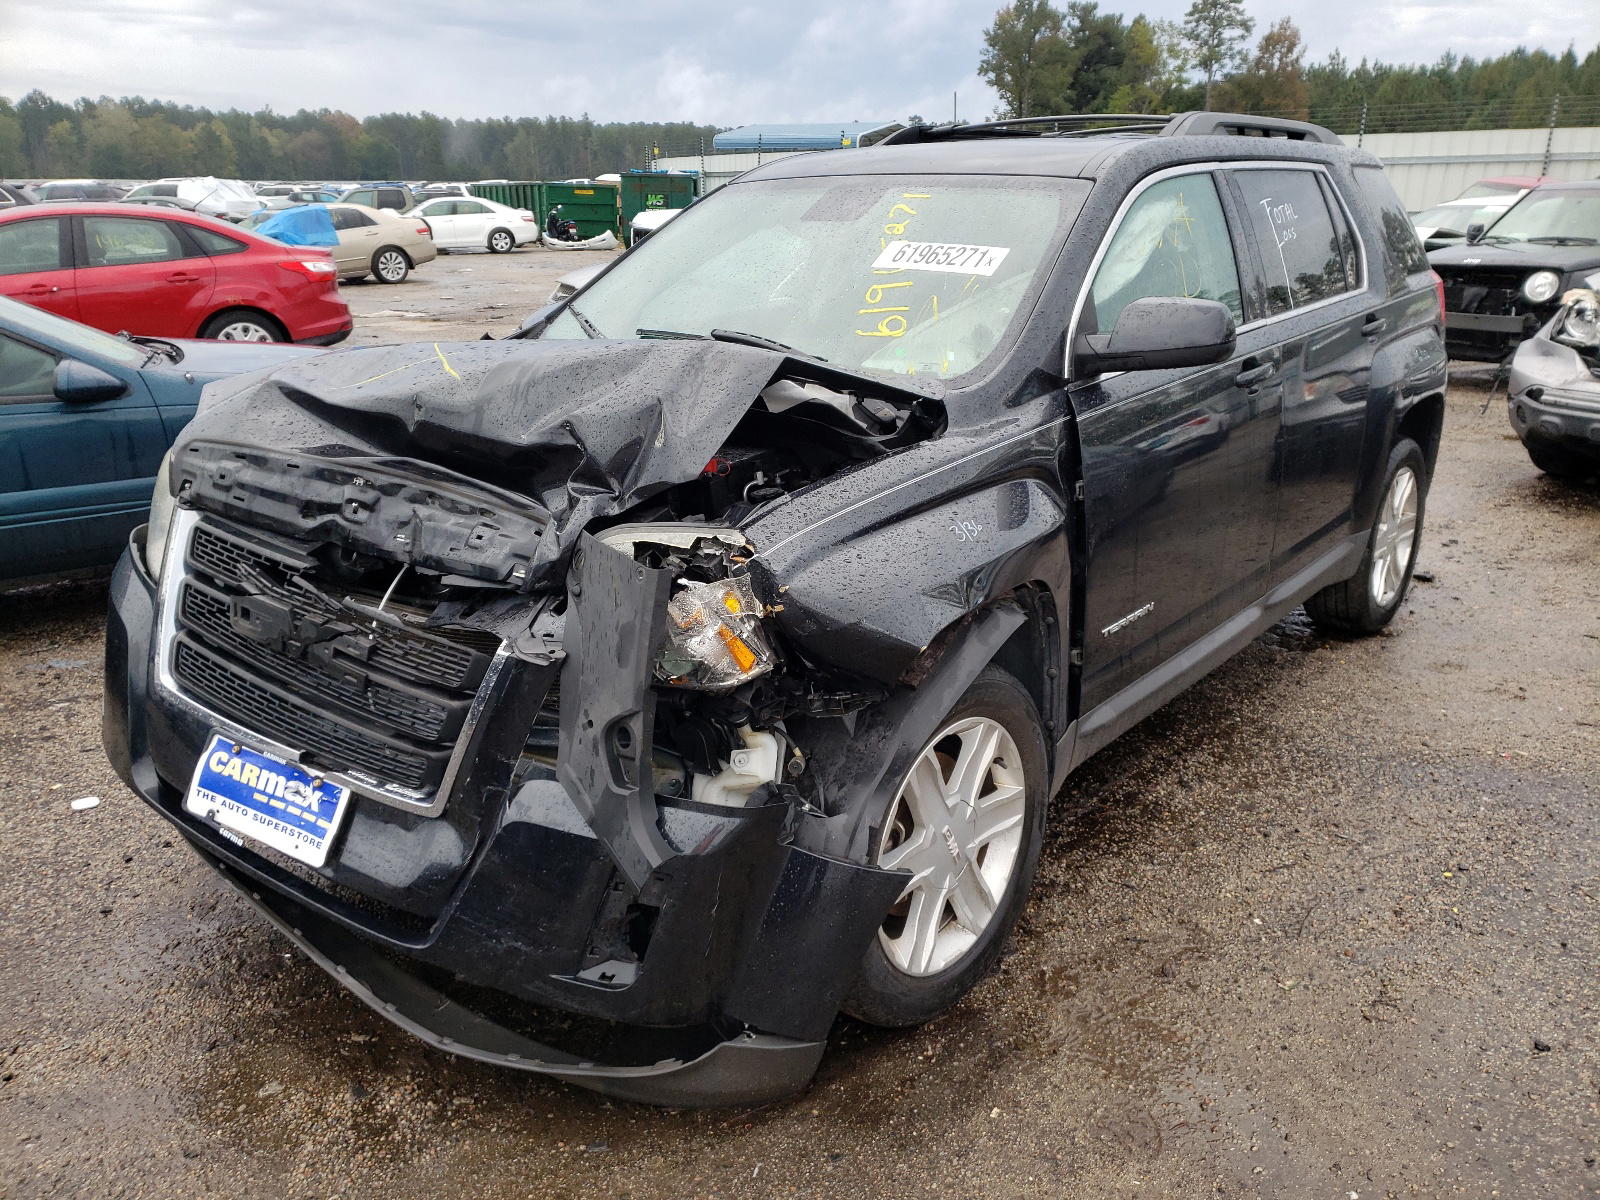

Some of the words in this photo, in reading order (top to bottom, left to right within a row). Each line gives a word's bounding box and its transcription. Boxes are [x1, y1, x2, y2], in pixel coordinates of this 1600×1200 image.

[856, 193, 932, 337] 619271
[196, 789, 217, 804] THE
[221, 798, 249, 817] AUTO
[252, 813, 323, 850] SUPERSTORE
